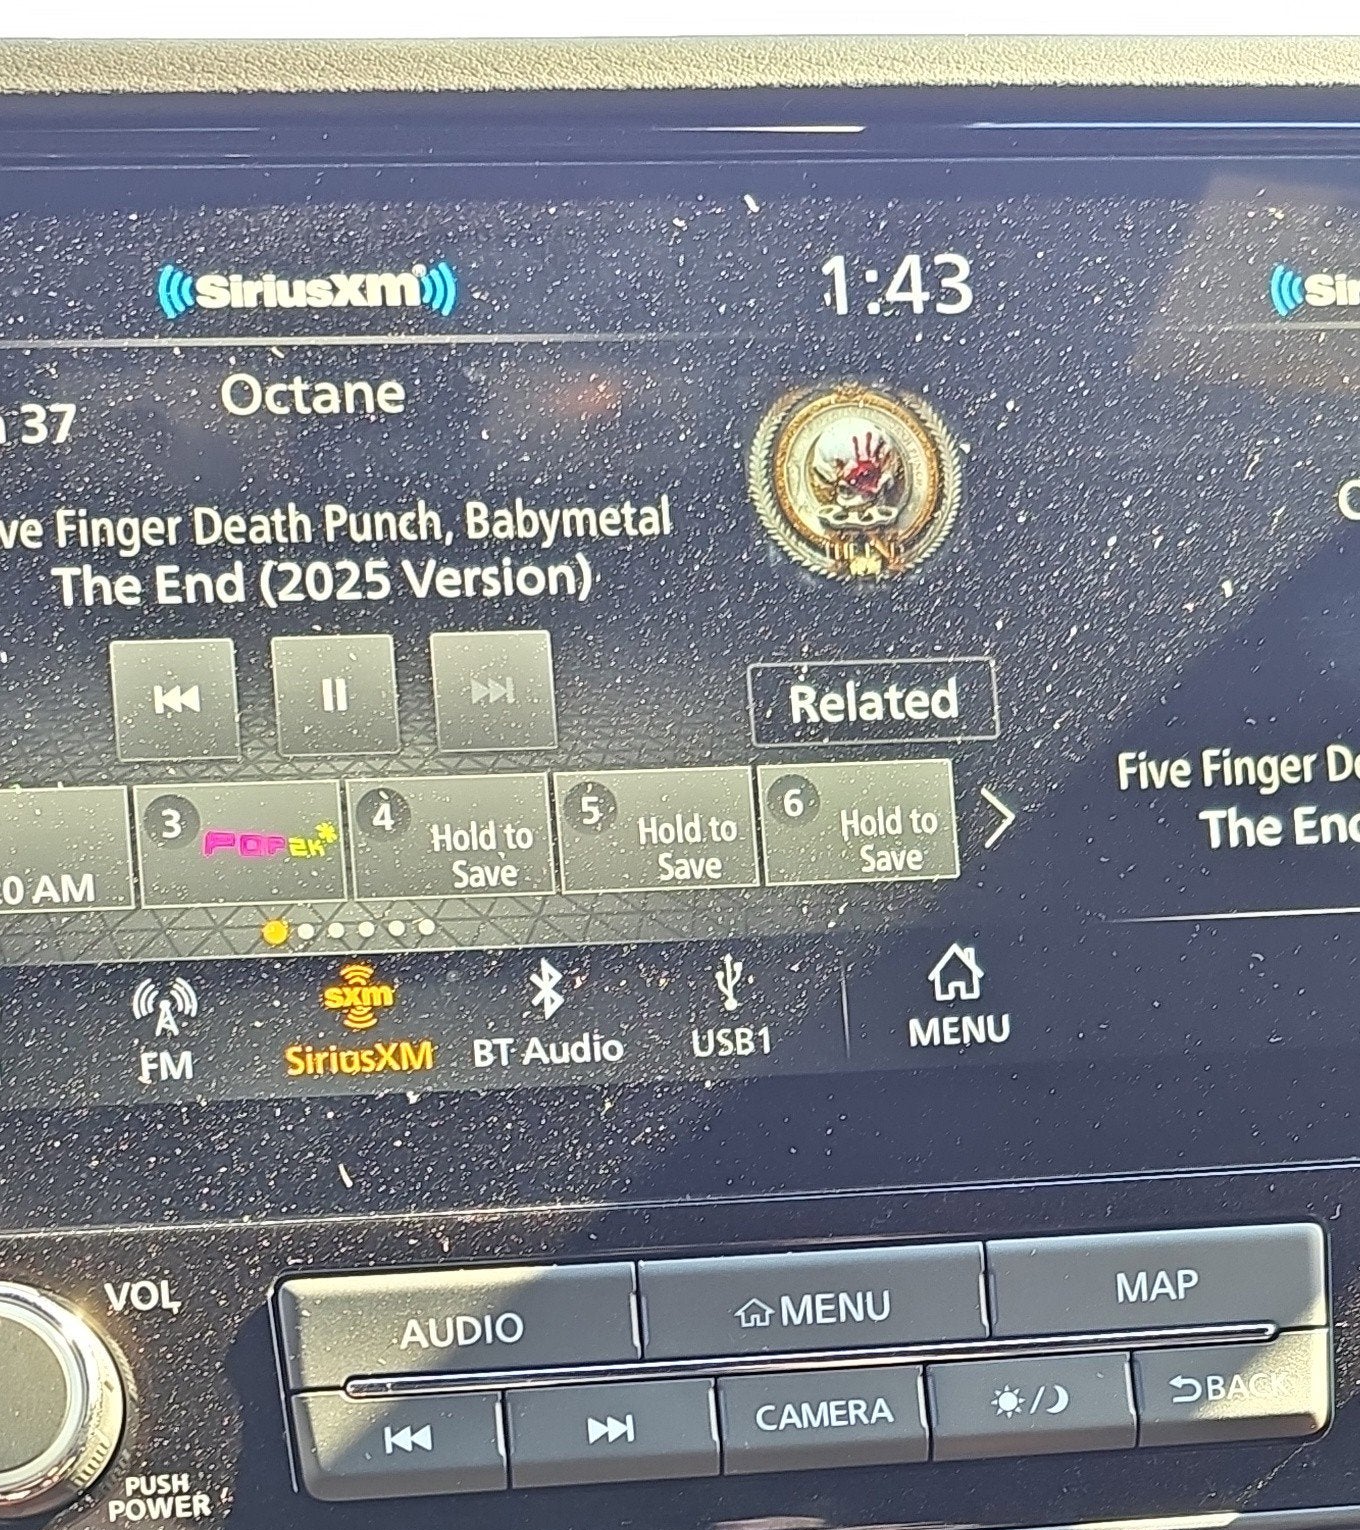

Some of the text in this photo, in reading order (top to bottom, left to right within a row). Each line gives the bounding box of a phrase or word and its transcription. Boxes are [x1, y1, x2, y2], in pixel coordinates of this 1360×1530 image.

[821, 254, 973, 315] 1:43
[221, 373, 406, 415] Octane
[20, 404, 76, 443] 37
[56, 507, 179, 560] Finger
[194, 505, 312, 546] Death
[325, 503, 454, 547] Punch,
[466, 497, 671, 548] Babymetal
[51, 553, 593, 608] The End (2025 Version)
[791, 681, 959, 724] Related
[1118, 751, 1191, 791] Five
[1202, 749, 1316, 794] Finger
[372, 803, 394, 831] 4
[581, 796, 601, 825] 5
[782, 787, 804, 818] 6
[161, 809, 182, 839] 3
[432, 821, 534, 855] Hold to
[638, 813, 738, 848] Hold to
[840, 806, 939, 841] Hold to
[1199, 809, 1283, 848] The
[452, 859, 519, 889] Save
[658, 851, 723, 883] Save
[860, 845, 924, 876] Save
[32, 873, 95, 904] AM
[691, 1026, 772, 1059] USB1
[908, 1013, 1011, 1048] MENU
[140, 1050, 193, 1080] FM
[286, 1040, 434, 1077] SiriusXM
[473, 1032, 625, 1069] BT Audio
[104, 1279, 181, 1314] VOL
[1116, 1268, 1199, 1304] MAP
[781, 1290, 892, 1327] MENU
[399, 1312, 524, 1350] AUDIO
[1207, 1373, 1288, 1402] BACK
[755, 1397, 895, 1432] CAMERA
[125, 1472, 190, 1496] PUSH
[107, 1494, 212, 1524] POWER
